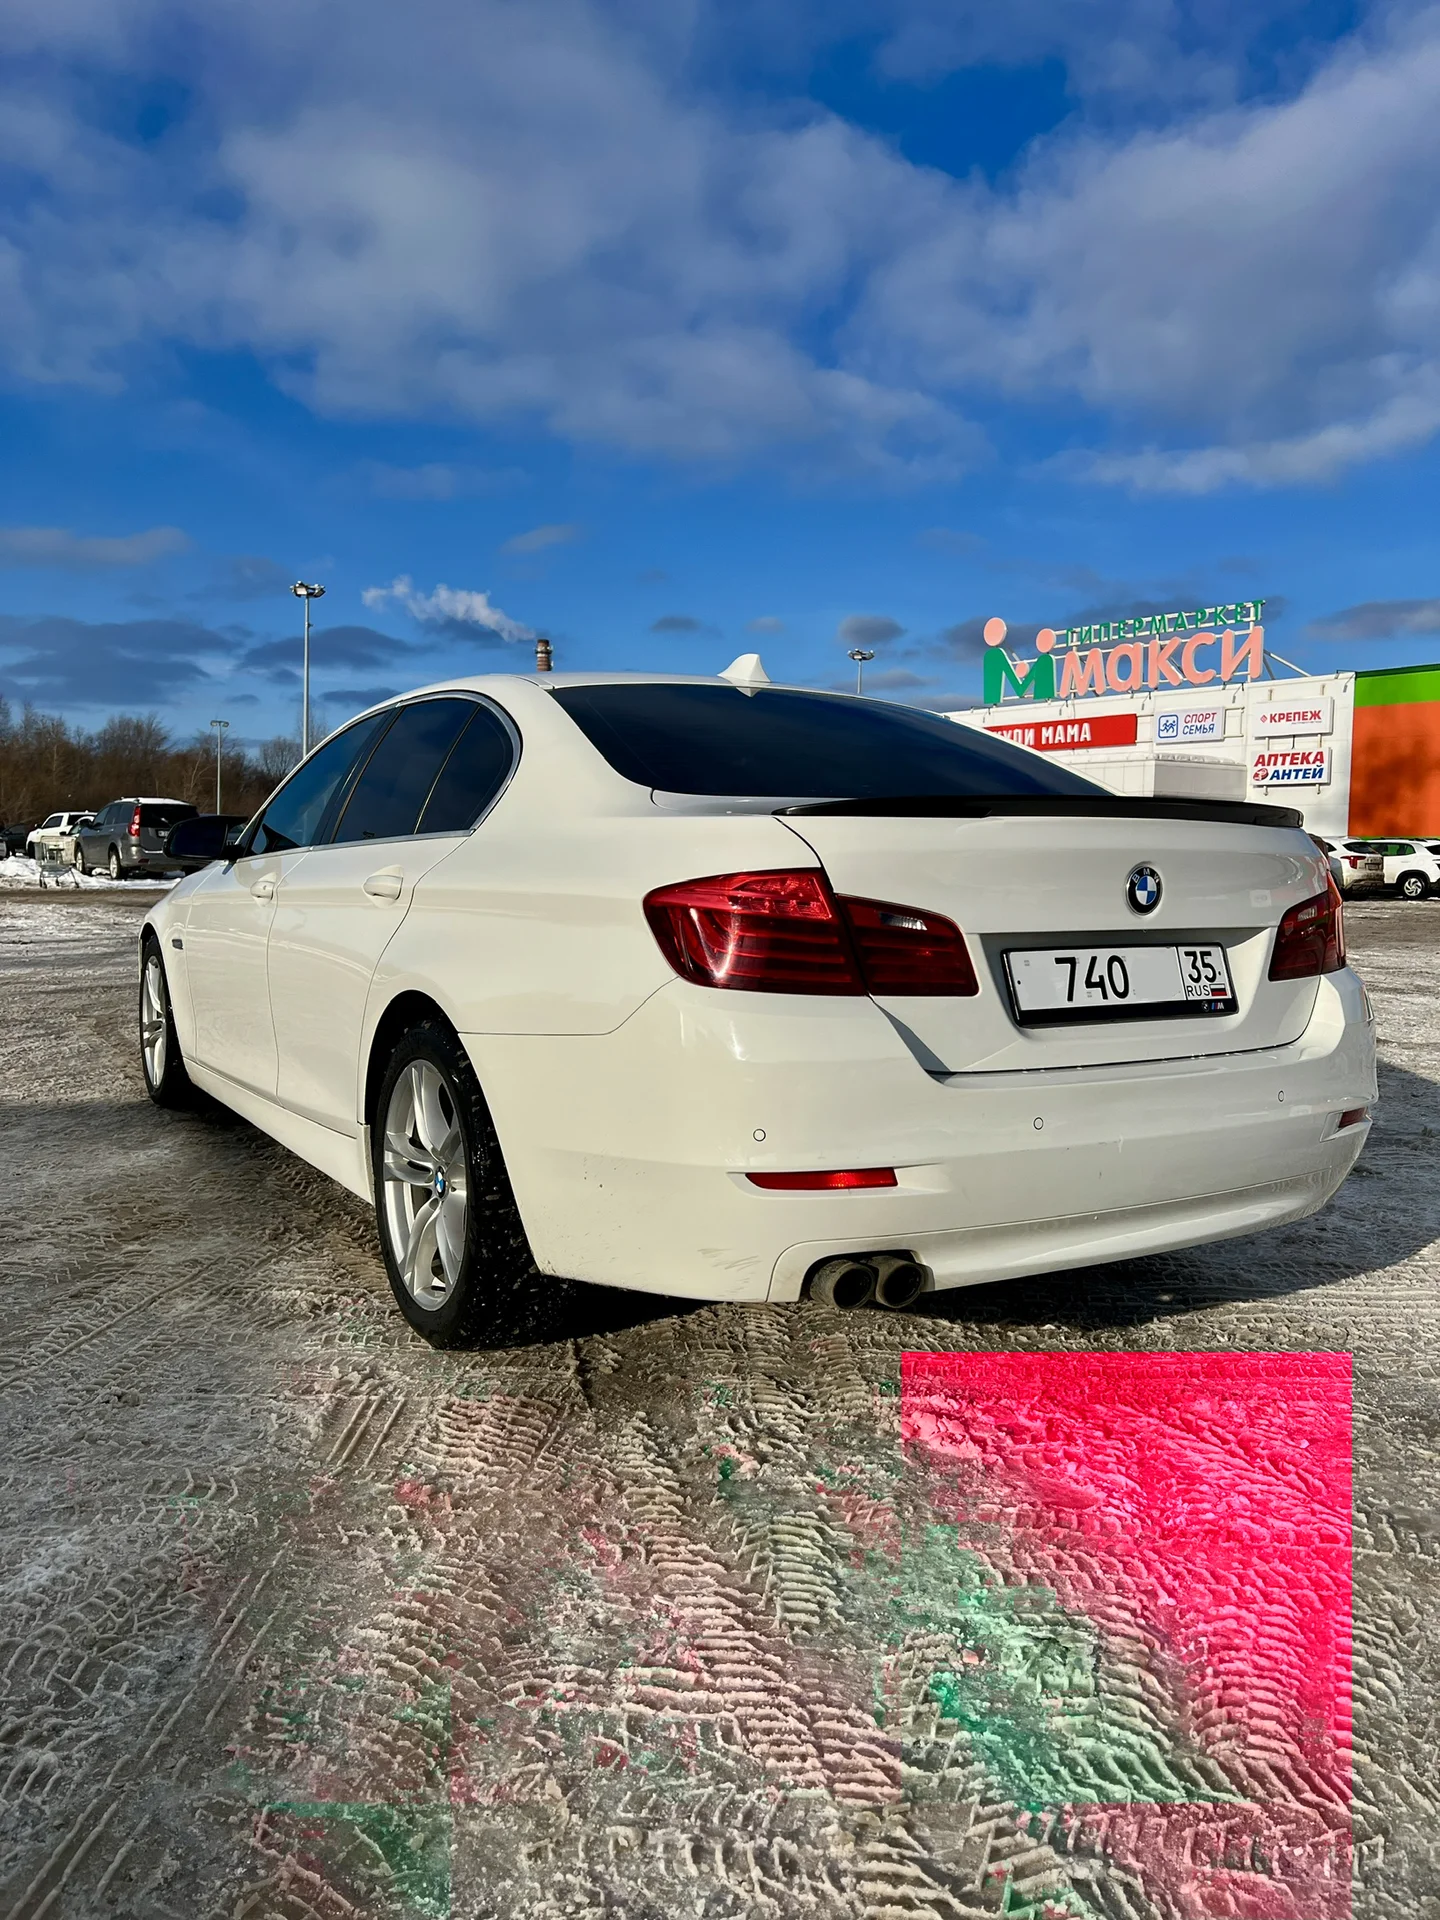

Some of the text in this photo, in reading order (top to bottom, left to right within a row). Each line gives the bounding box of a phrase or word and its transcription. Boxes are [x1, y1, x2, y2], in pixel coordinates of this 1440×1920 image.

[1066, 600, 1265, 647] ГИПЕРМАРКЕТ
[1184, 712, 1217, 724] СПОРТ
[1269, 710, 1322, 723] КРЕПЕЖ
[1041, 723, 1092, 745] МАМА
[1182, 724, 1215, 735] СЕМЬЯ
[1254, 751, 1324, 767] АПТЕКА
[1269, 764, 1324, 780] АНТЕЙ
[1132, 868, 1160, 884] BMW
[1054, 950, 1217, 1003] 740 35
[1187, 984, 1210, 997] RUS
